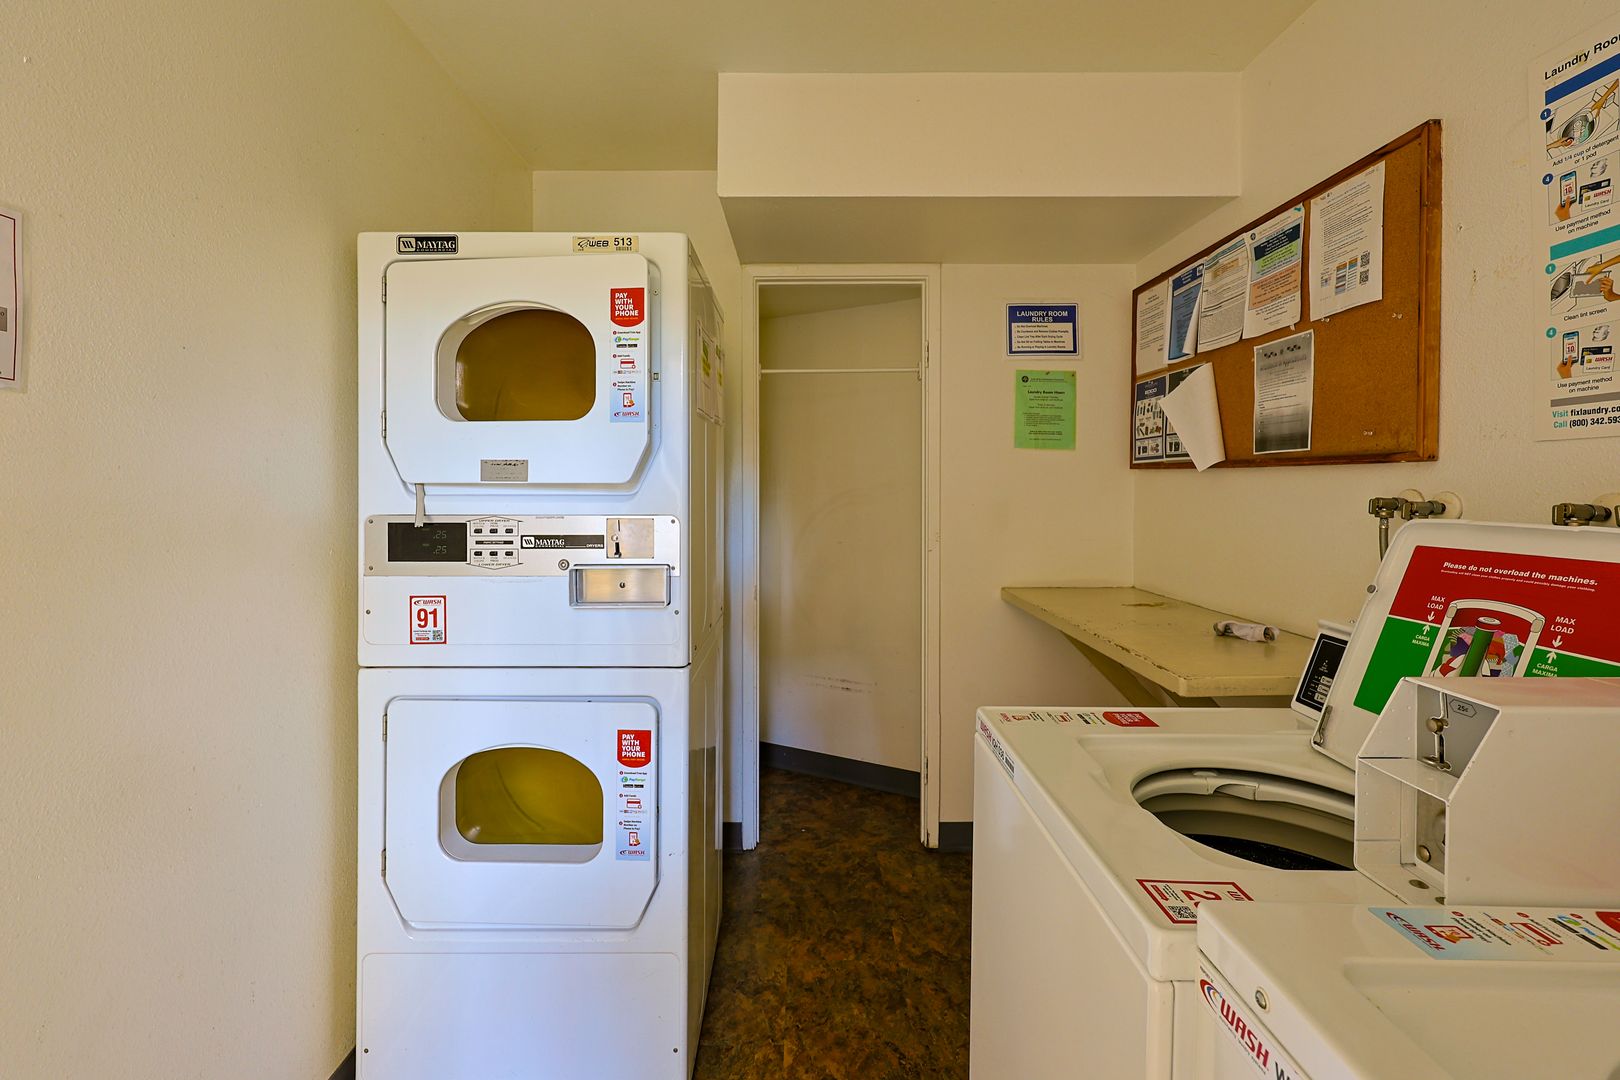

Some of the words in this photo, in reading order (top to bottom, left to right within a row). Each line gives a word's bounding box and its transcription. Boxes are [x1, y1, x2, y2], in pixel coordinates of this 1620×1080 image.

[1544, 50, 1590, 80] Laundry
[1594, 34, 1620, 54] Roo
[1552, 158, 1564, 168] Add
[1592, 134, 1620, 150] detergent
[1586, 150, 1597, 160] pod
[1566, 216, 1590, 228] payment
[1590, 208, 1611, 220] method
[1576, 220, 1599, 232] machine
[416, 240, 455, 249] MAYTAG
[614, 237, 632, 246] 513
[1589, 308, 1607, 316] screen
[1568, 379, 1591, 388] payment
[1570, 418, 1588, 428] (800)
[1443, 561, 1467, 570] Please
[1494, 568, 1530, 577] overload
[1548, 575, 1598, 586] machines.
[417, 608, 437, 628] 91
[1555, 616, 1576, 625] MAX
[1550, 624, 1574, 634] LOAD
[1536, 663, 1558, 672] CARGA
[1181, 890, 1222, 908] 2
[1402, 923, 1445, 950] WASH
[1220, 998, 1270, 1068] WASH
